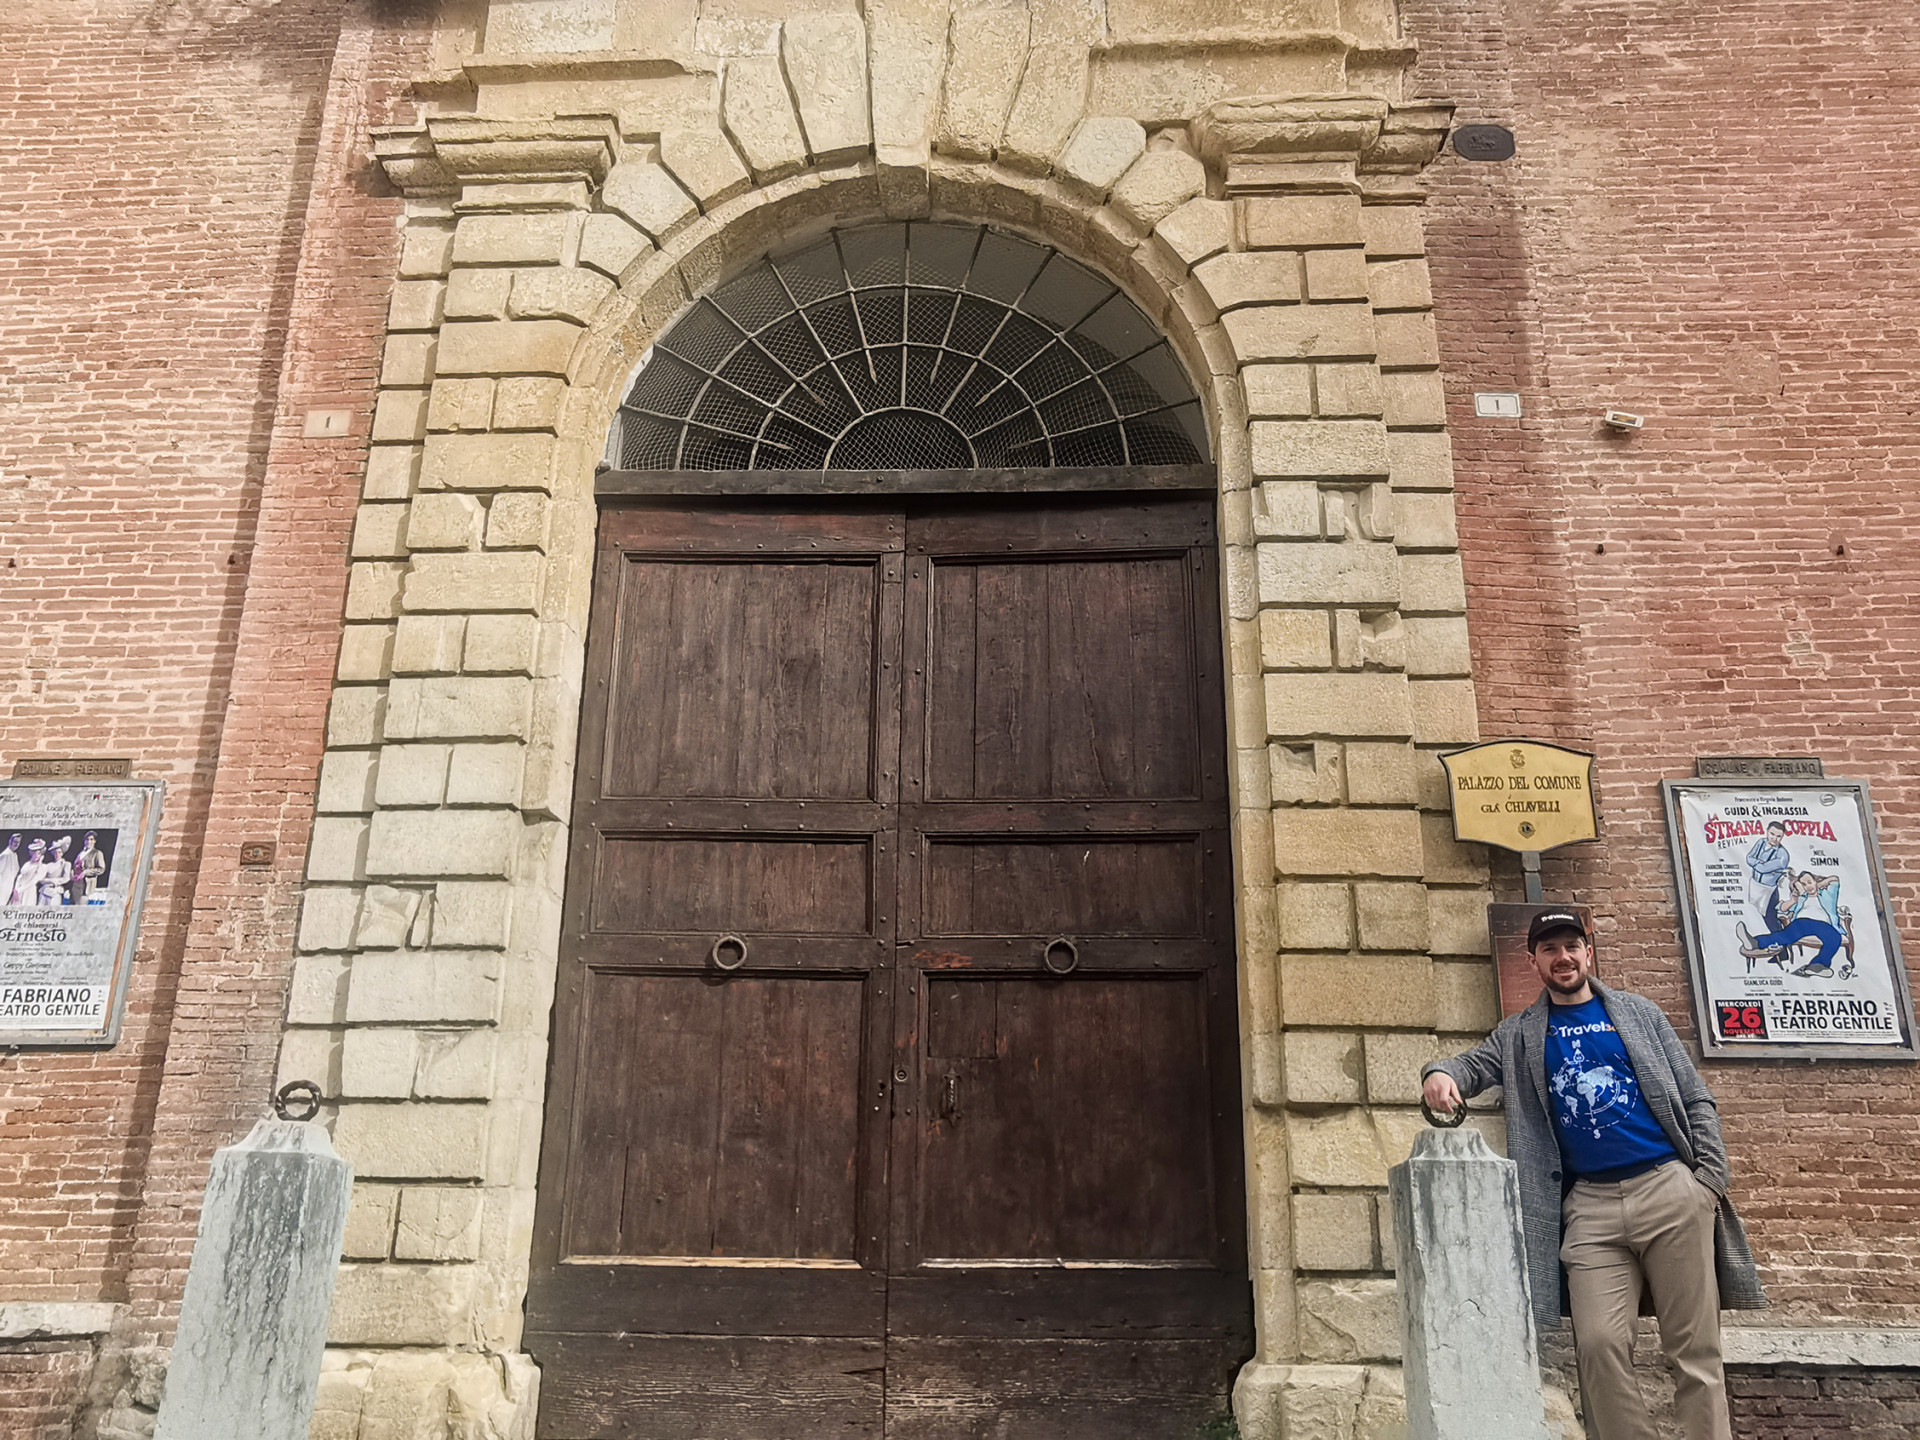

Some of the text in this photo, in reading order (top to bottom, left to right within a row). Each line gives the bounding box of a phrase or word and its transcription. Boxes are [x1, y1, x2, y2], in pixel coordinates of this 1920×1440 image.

[1764, 763, 1816, 774] FABRIANO
[1458, 776, 1581, 790] PALAZZO DEL COMUNE
[1505, 800, 1561, 813] CHIAVELLI
[1724, 805, 1809, 817] GUIDI & INGRASSIA
[1708, 813, 1719, 821] LA
[1704, 819, 1838, 843] STRANA COPPIA
[1717, 837, 1748, 850] REVIVAL
[1810, 857, 1839, 866] SIMON
[0, 927, 67, 942] Ernesto
[3, 988, 91, 1003] FABRIANO
[45, 1004, 101, 1016] GENTILE
[1782, 1000, 1877, 1015] FABRIANO
[1722, 1007, 1761, 1028] 26
[1771, 1016, 1893, 1030] TEATRO GENTILE
[1571, 1039, 1581, 1049] N
[1593, 1129, 1601, 1139] S
